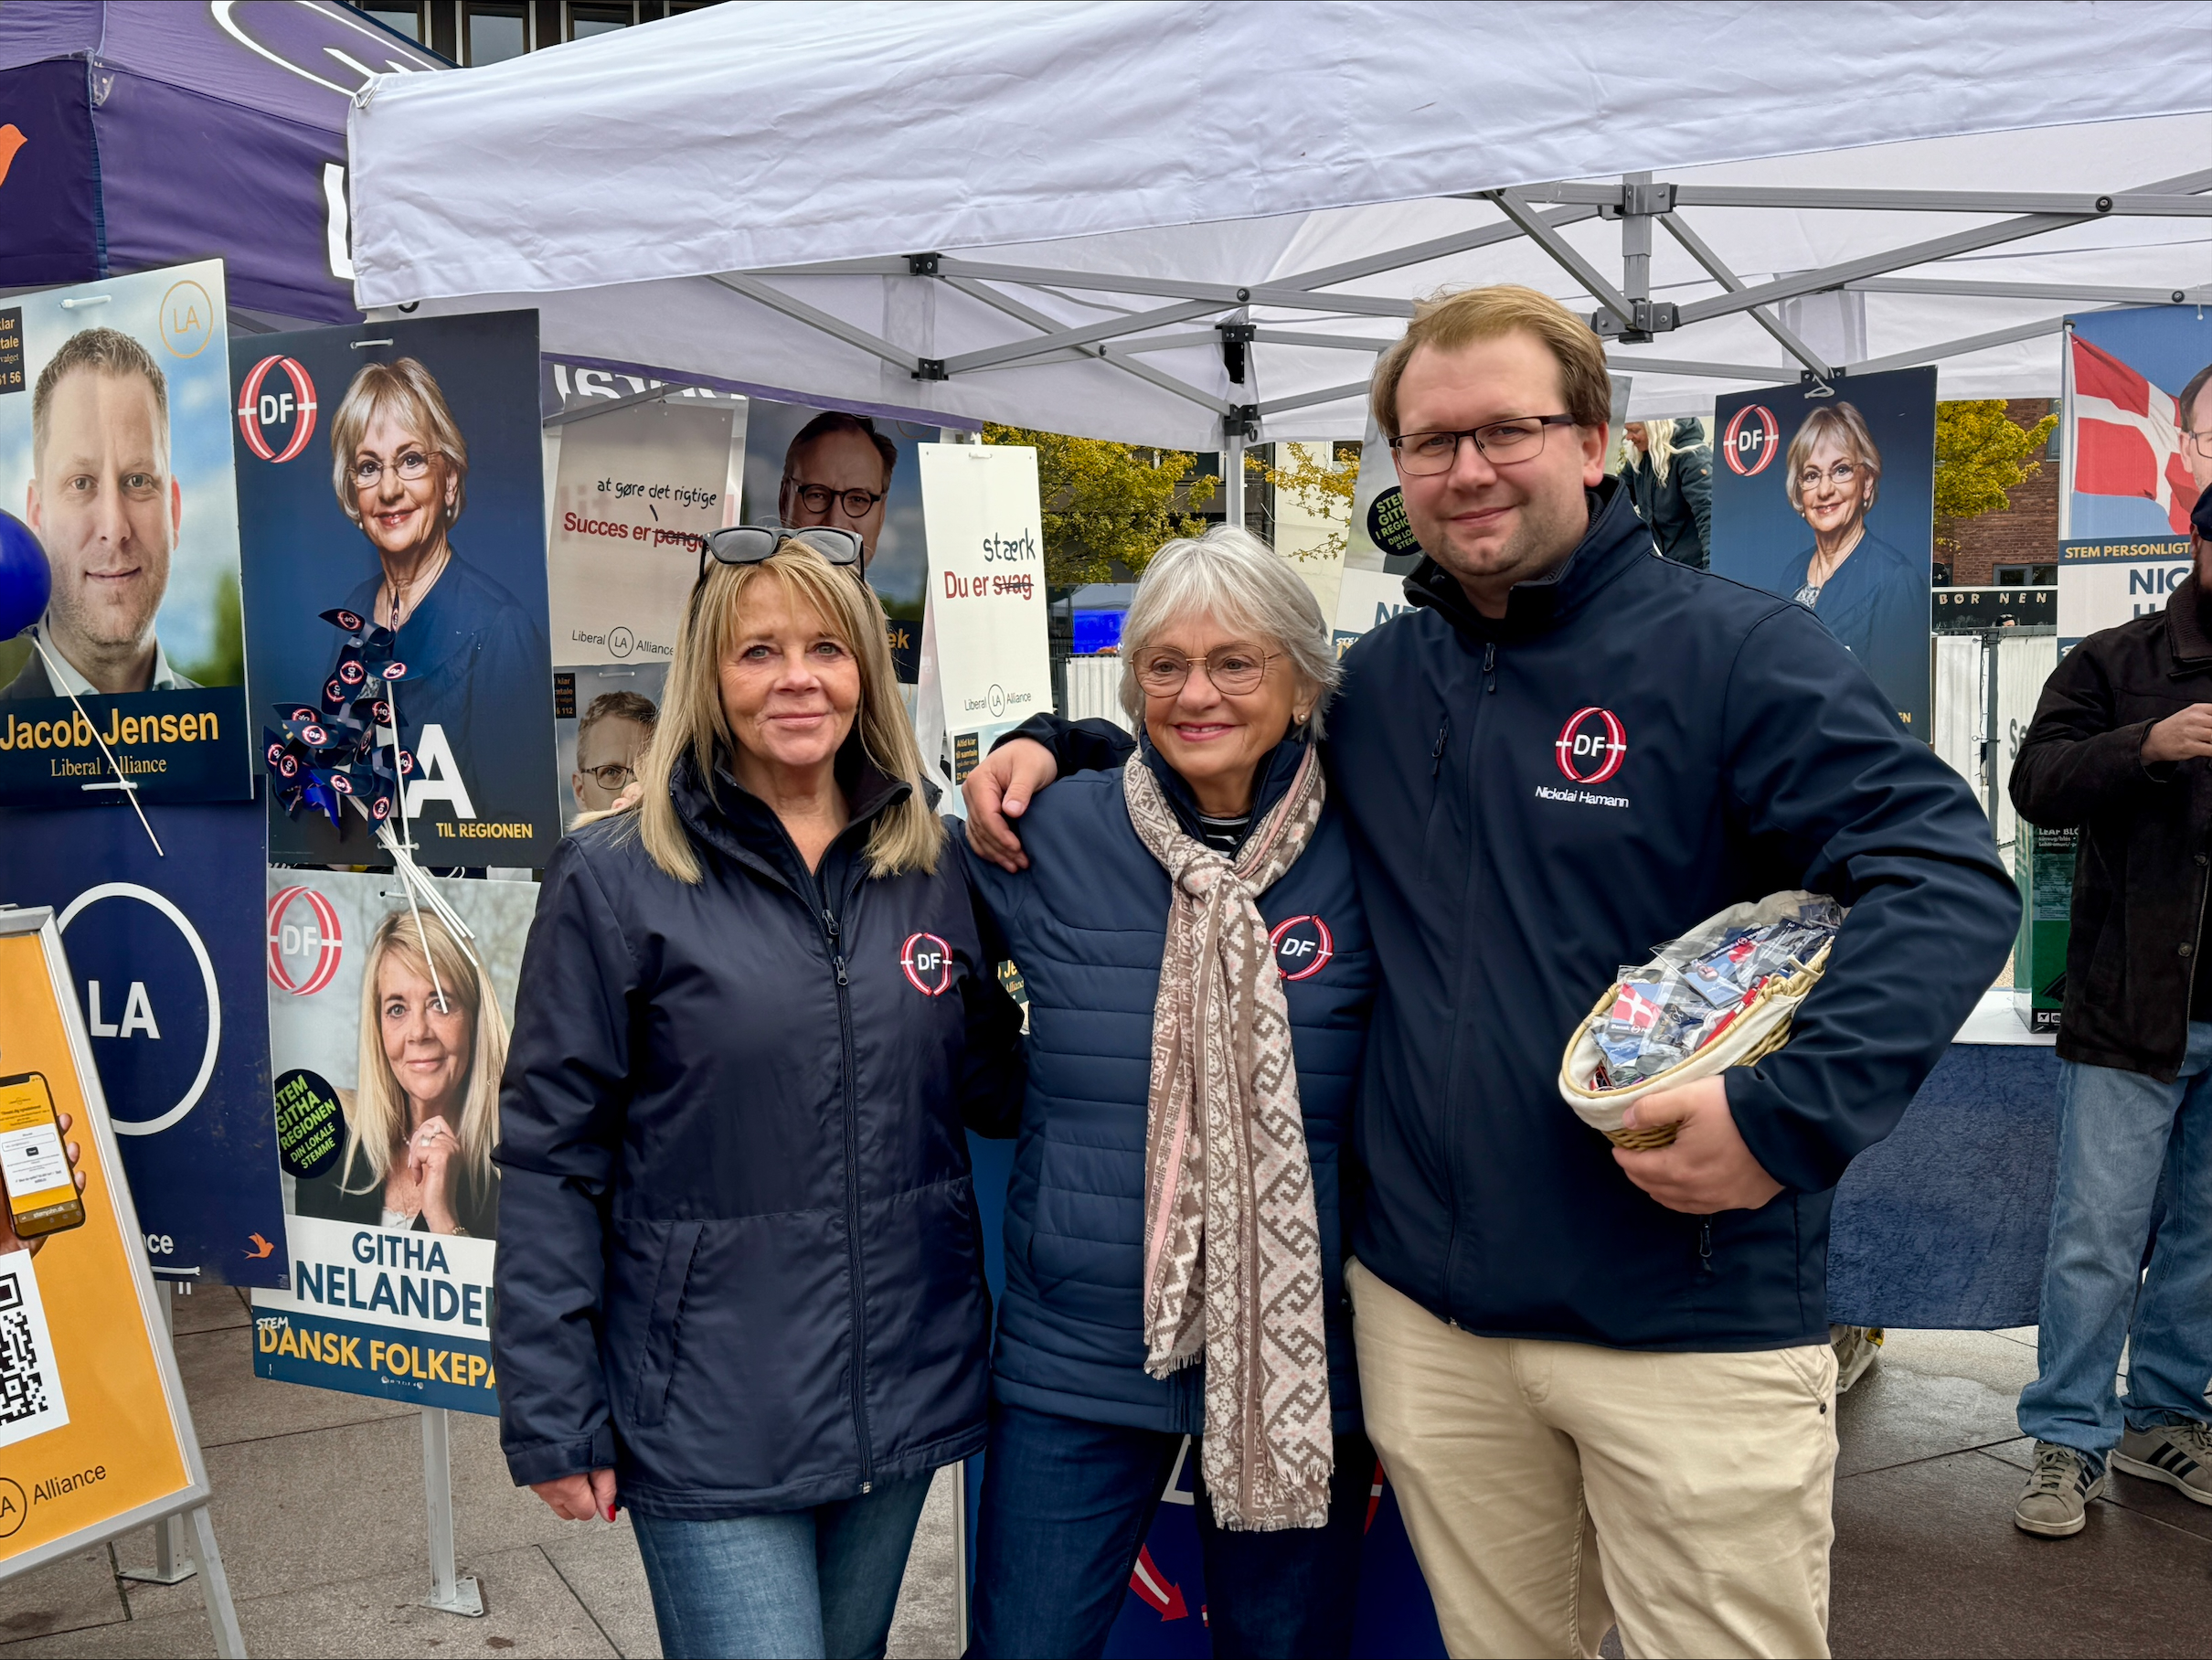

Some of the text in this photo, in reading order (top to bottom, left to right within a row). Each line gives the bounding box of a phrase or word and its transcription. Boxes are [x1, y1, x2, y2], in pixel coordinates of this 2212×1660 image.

[174, 305, 201, 334] LA
[10, 370, 22, 384] 56
[261, 392, 294, 425] DF
[1739, 430, 1763, 452] DF
[597, 477, 718, 510] at gøre det rigtige
[563, 512, 629, 539] Succes
[633, 524, 653, 542] er
[1388, 534, 1402, 546] DIN
[983, 527, 1037, 562] stærk
[2064, 542, 2191, 559] STEM PERSONLIGT
[943, 570, 1034, 601] Du er svag
[571, 629, 674, 656] Liberal LA Alliance
[964, 691, 1032, 711] Liberal LA Alliance
[0, 708, 219, 750] Jacob Jensen
[1572, 734, 1606, 757] DF
[50, 755, 167, 776] Liberal Alliance
[1535, 785, 1630, 808] Nickolai Hamann
[435, 822, 534, 839] TIL REGIONEN
[282, 924, 317, 956] DF
[1281, 937, 1316, 957] DF
[917, 952, 941, 970] DF
[88, 979, 161, 1039] LA
[276, 1090, 322, 1133] GITHA
[280, 1098, 336, 1151] REGIONEN
[290, 1122, 335, 1163] DIN LOKALE
[301, 1136, 335, 1169] STEMME
[352, 1230, 451, 1275] GITHA
[256, 1315, 289, 1331] STEM
[259, 1326, 364, 1369] DANSK
[33, 1464, 107, 1506] Alliance
[0, 1495, 16, 1519] A
